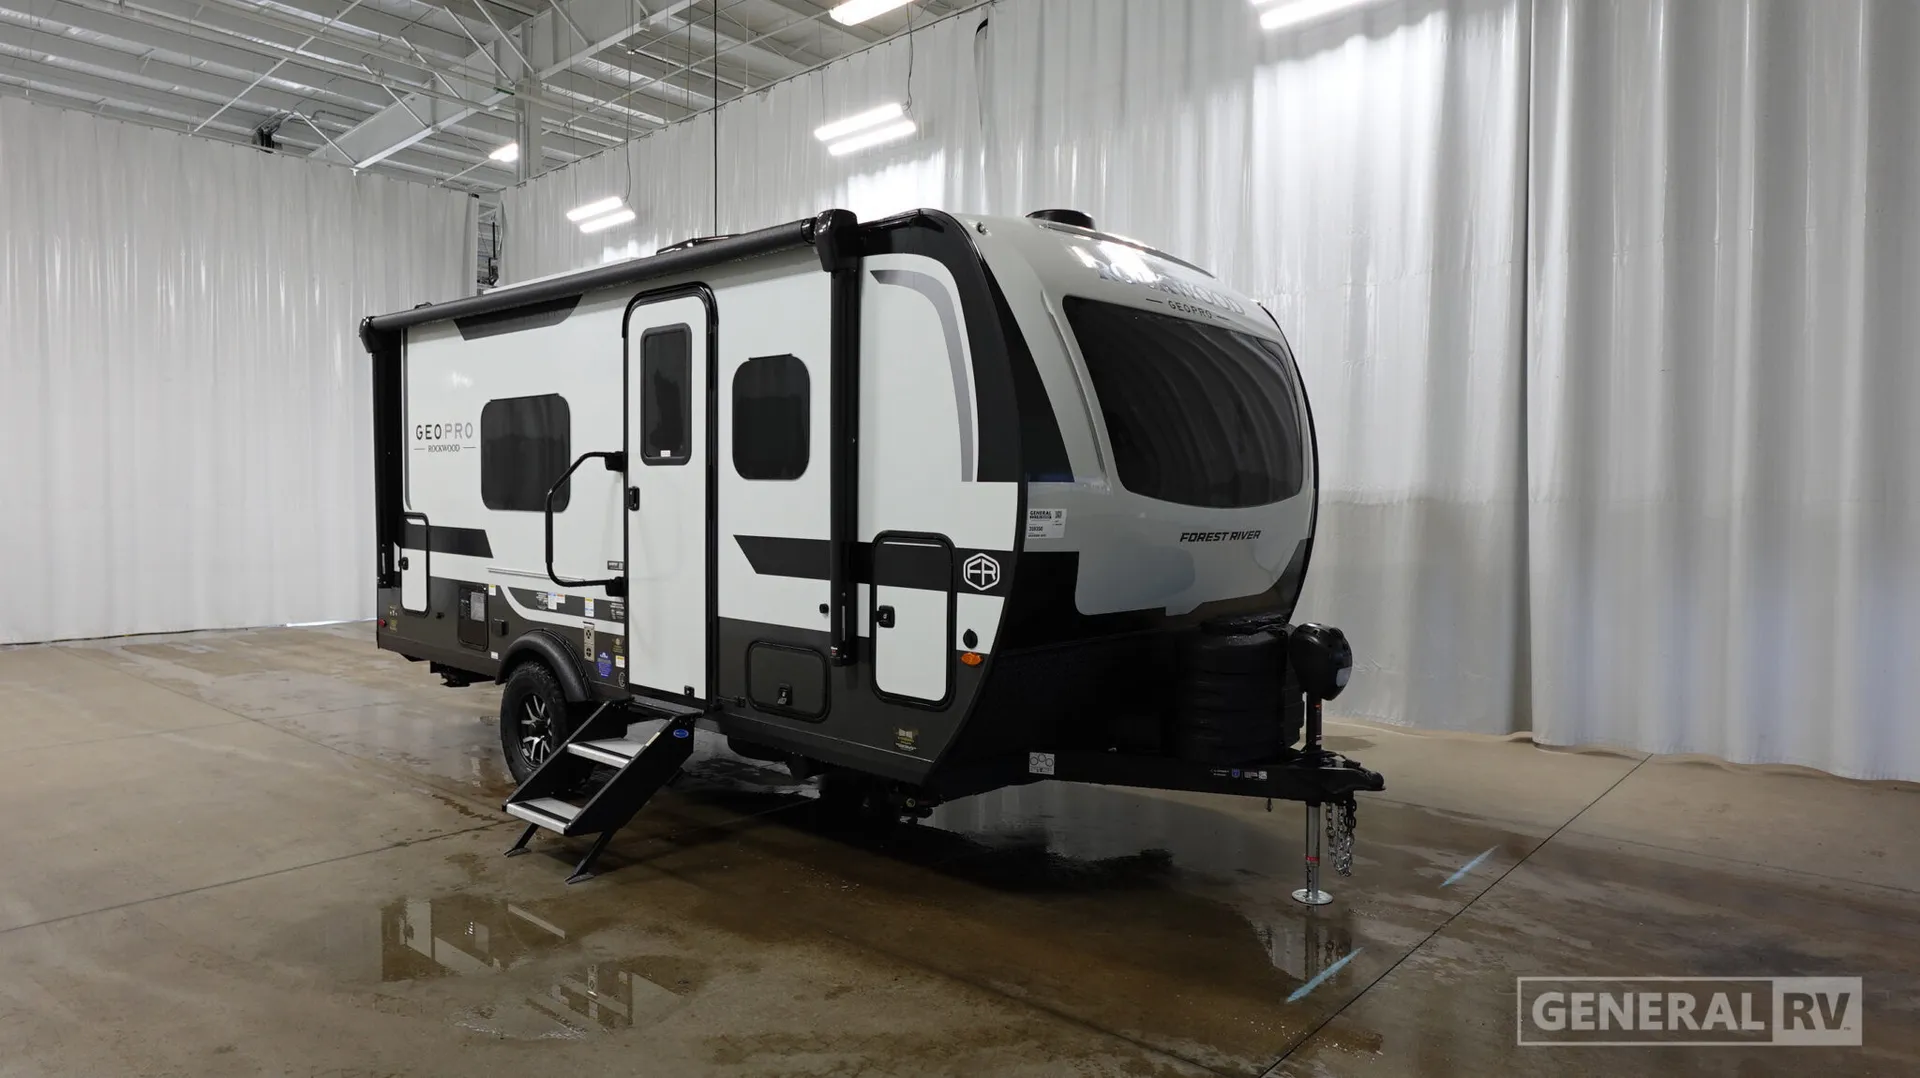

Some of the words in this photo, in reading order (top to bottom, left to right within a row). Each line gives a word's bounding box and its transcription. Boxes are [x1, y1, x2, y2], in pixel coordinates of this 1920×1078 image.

[1168, 299, 1213, 320] GEOPRO
[427, 443, 461, 453] ROCKWOOD
[1179, 531, 1229, 543] FOREST
[1229, 530, 1262, 541] RIVER
